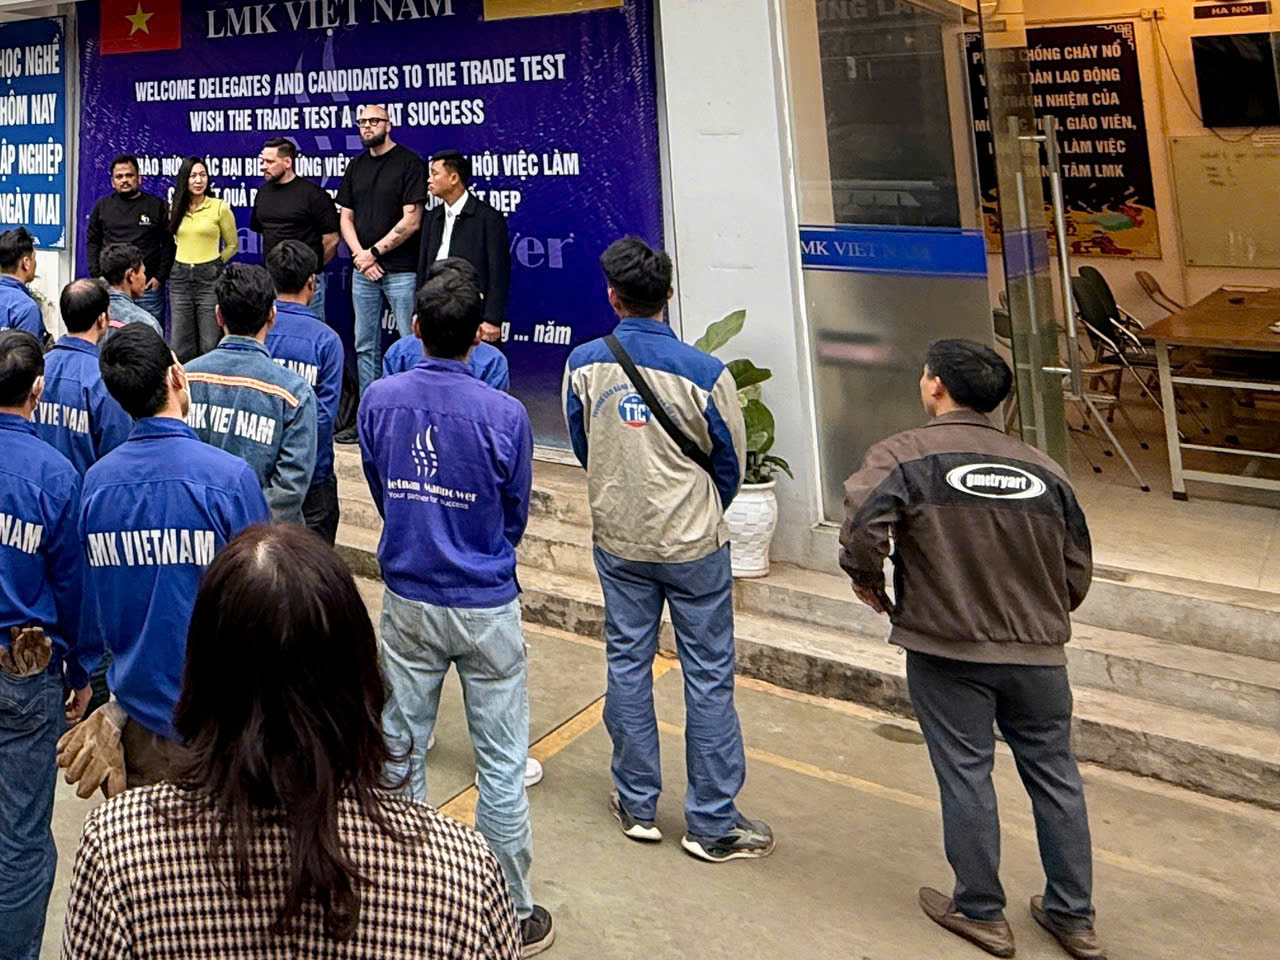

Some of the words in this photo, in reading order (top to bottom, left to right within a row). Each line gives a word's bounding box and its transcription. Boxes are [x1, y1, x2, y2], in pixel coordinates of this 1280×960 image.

[206, 3, 278, 39] LMK
[24, 34, 61, 77] NGHỀ
[135, 75, 196, 102] WELCOME
[199, 69, 271, 100] DELEGATES
[274, 68, 305, 96] AND
[307, 65, 399, 95] CANDIDATES
[402, 63, 423, 89] TO
[425, 60, 457, 87] THE
[459, 56, 518, 86] TRADE
[519, 53, 567, 82] TEST
[1056, 69, 1080, 83] LAO
[1083, 67, 1121, 85] ĐỘNG
[0, 89, 28, 126] HÔM
[31, 93, 58, 125] NAY
[1046, 91, 1089, 109] NHIỆM
[1092, 87, 1120, 106] CỦA
[189, 108, 224, 133] WISH
[227, 107, 253, 132] THE
[255, 106, 300, 131] TRADE
[302, 104, 340, 129] TEST
[341, 104, 353, 128] A
[407, 99, 485, 128] SUCCESS
[18, 136, 63, 182] NGHIỆP
[1064, 138, 1093, 154] LÀM
[1096, 137, 1126, 157] VIỆC
[137, 154, 160, 176] HÀO
[222, 156, 244, 180] ĐẠI
[472, 151, 499, 181] HỘI
[502, 149, 539, 180] VIỆC
[543, 149, 580, 176] LÀM
[1062, 163, 1092, 178] TÂM
[1094, 164, 1125, 178] LMK
[34, 193, 61, 225] MAI
[223, 182, 248, 208] QUẢ
[533, 320, 572, 345] năm
[234, 410, 276, 445] NAM
[387, 478, 421, 492] ietnam
[88, 531, 121, 568] LMK
